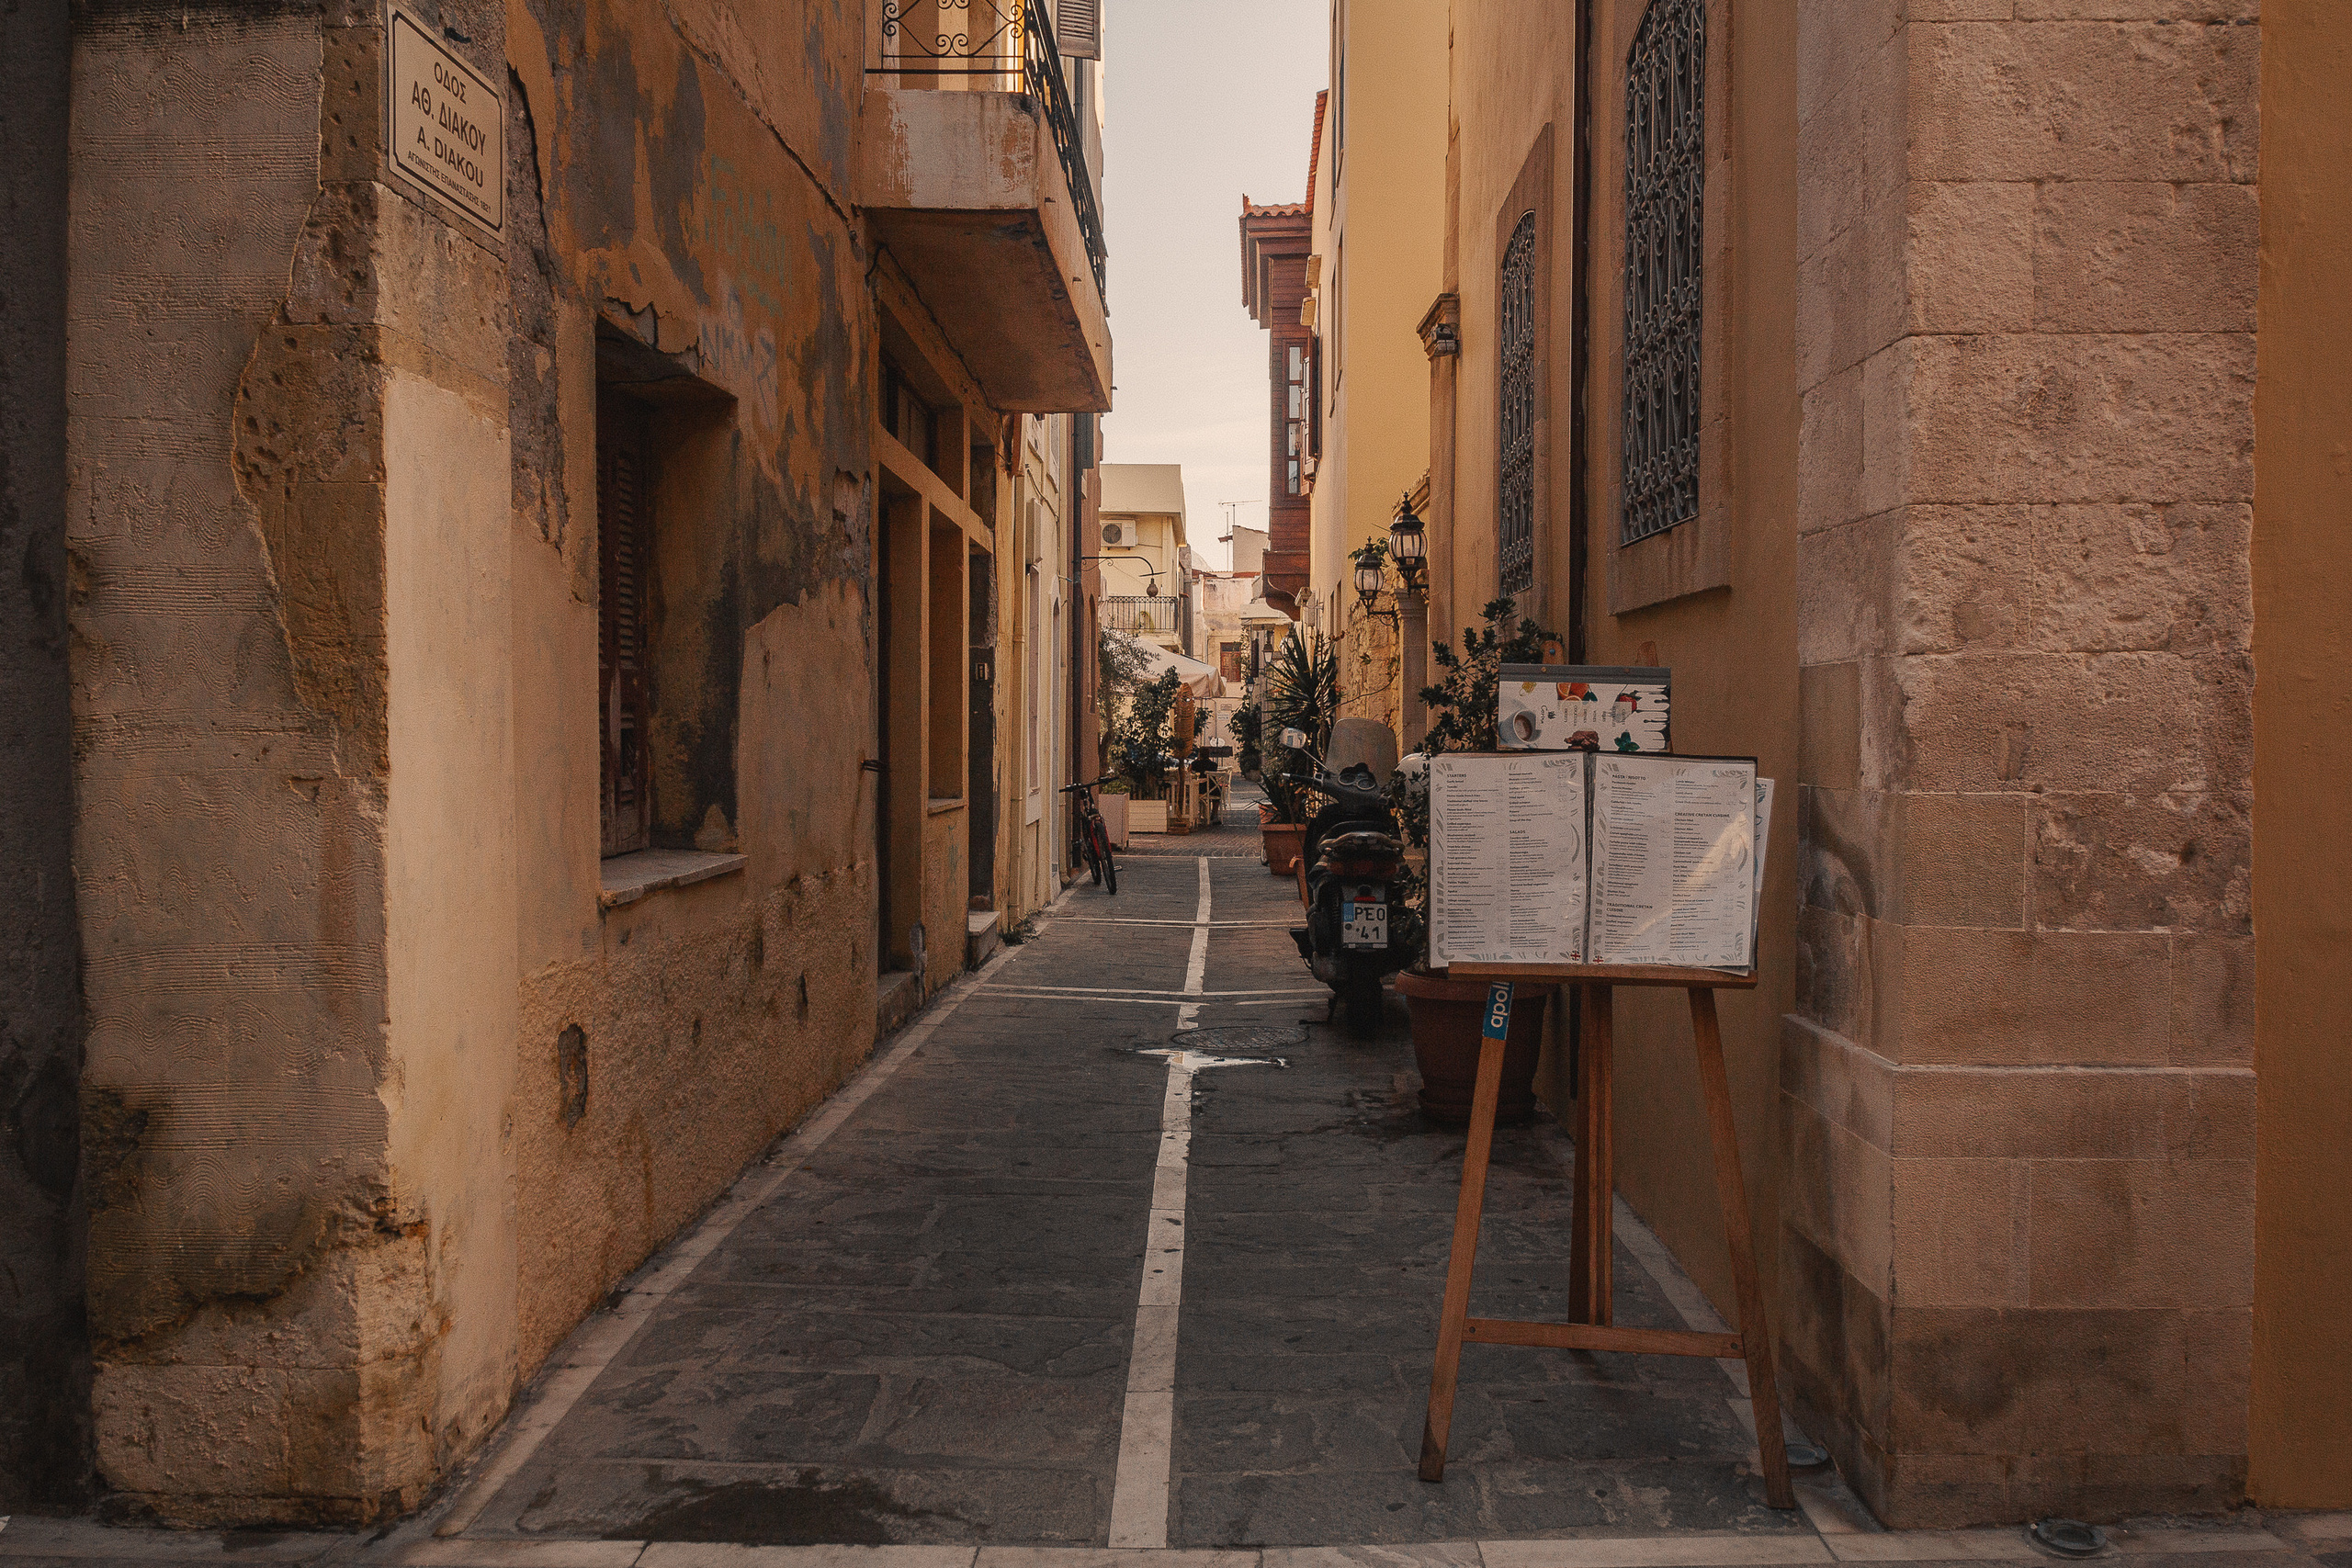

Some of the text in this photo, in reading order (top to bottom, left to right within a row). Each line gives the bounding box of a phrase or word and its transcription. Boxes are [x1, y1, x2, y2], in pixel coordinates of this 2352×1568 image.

[434, 62, 467, 105] ΟΔΟΣ
[412, 81, 486, 156] ΑΘ. ΔΙΑΚΟΥ
[407, 150, 441, 182] ΑΓΩΝΙΣΤΗΣ
[480, 198, 492, 214] 1821
[417, 126, 483, 188] A. DIAKOU
[1361, 926, 1379, 939] 41
